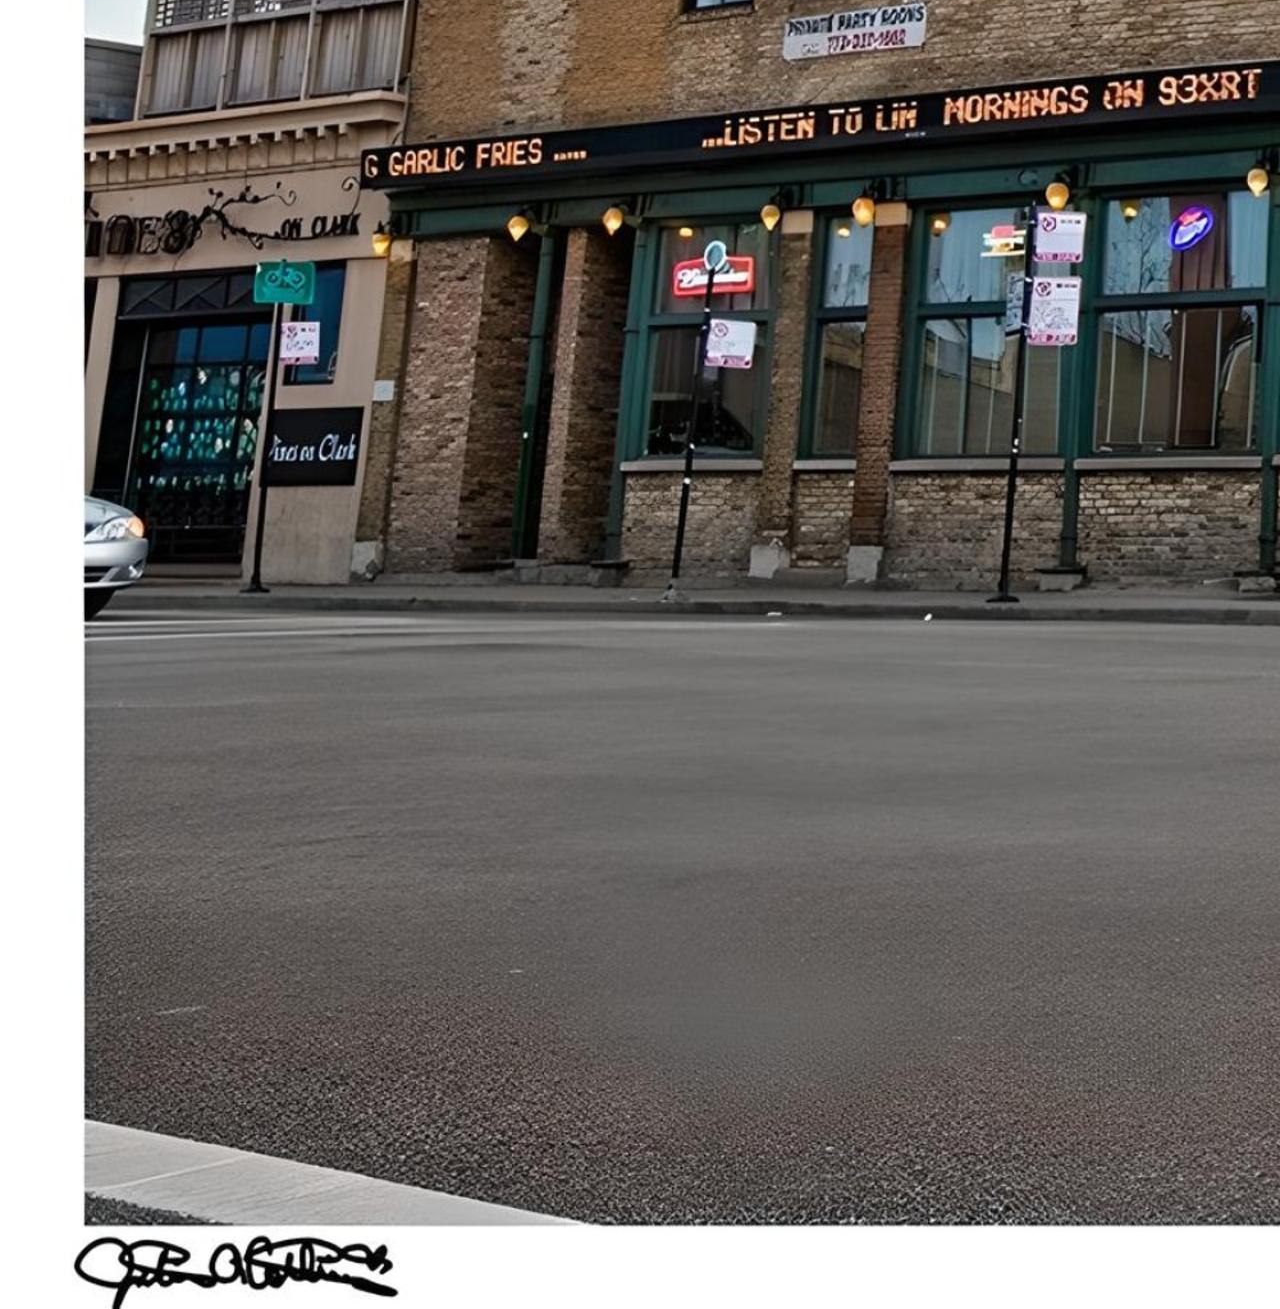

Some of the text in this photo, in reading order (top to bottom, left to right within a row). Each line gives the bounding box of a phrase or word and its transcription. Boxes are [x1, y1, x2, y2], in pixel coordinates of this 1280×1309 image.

[828, 107, 863, 135] TO
[943, 85, 1089, 125] MORNINGS
[1103, 80, 1144, 110] ON
[1158, 68, 1262, 106] 93XRT
[389, 145, 464, 177] GARLIC
[476, 138, 543, 169] FRIES
